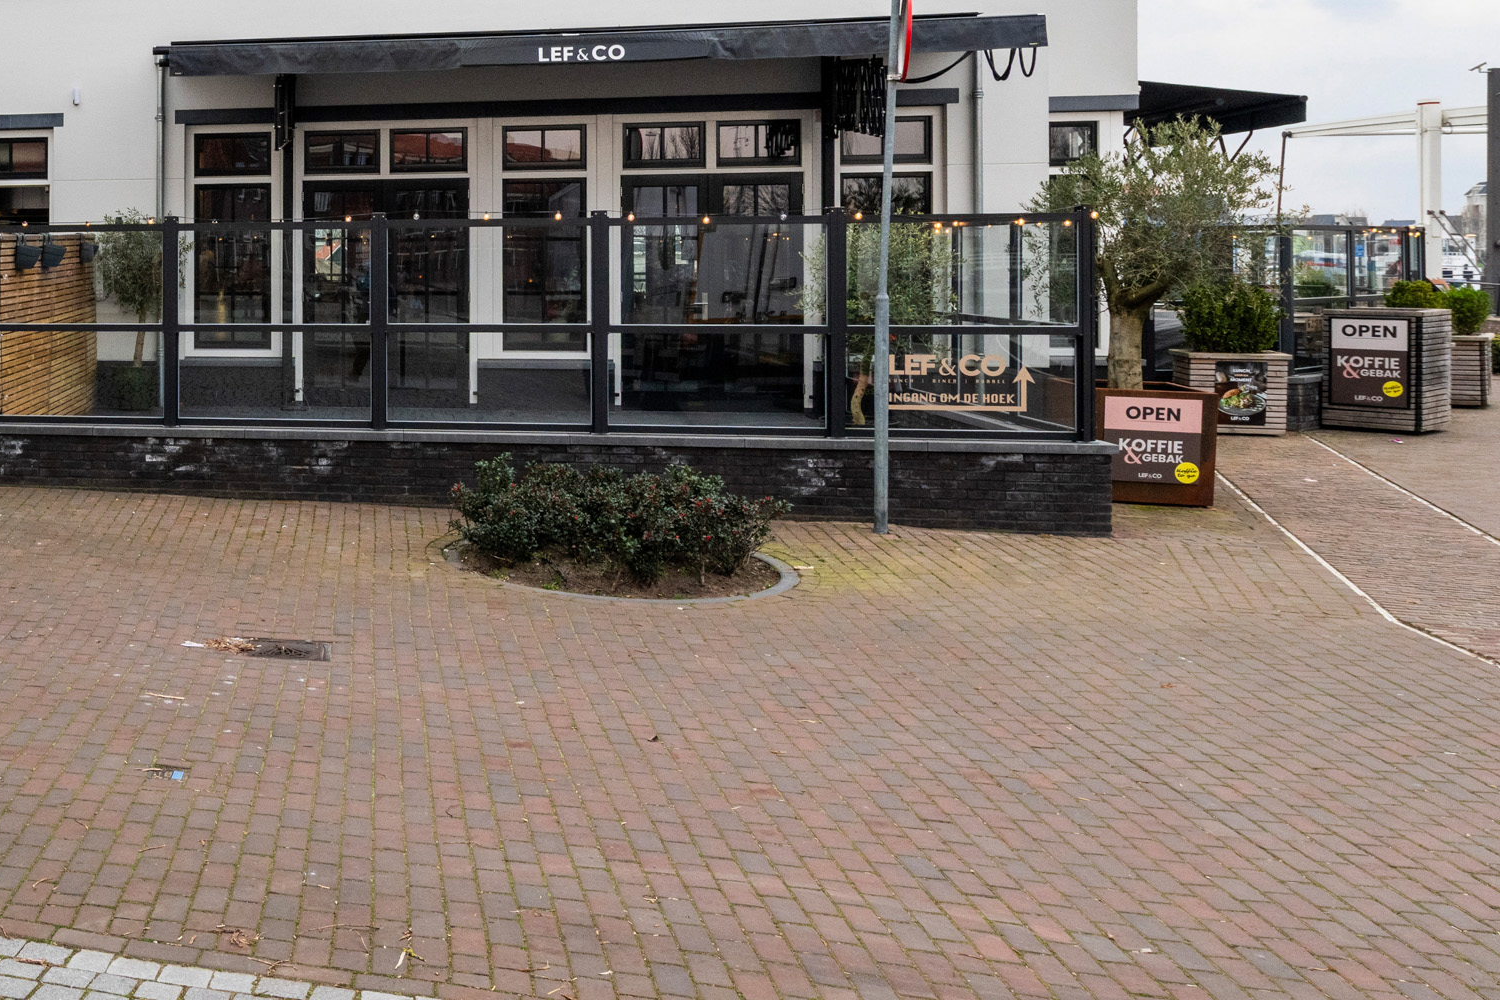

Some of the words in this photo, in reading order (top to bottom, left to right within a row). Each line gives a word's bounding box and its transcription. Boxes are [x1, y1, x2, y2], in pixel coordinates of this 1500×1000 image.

[538, 44, 626, 62] LEF&CO
[1341, 324, 1397, 338] OPEN
[1337, 355, 1400, 369] KOFFIE
[1360, 369, 1401, 378] GEBAK
[888, 393, 937, 403] INGANG
[940, 393, 961, 403] OM
[964, 393, 979, 404] DE
[982, 393, 1015, 404] HOEK
[1126, 406, 1181, 422] OPEN
[1119, 438, 1183, 454] KOFFIE
[1141, 453, 1184, 464] GEBAK
